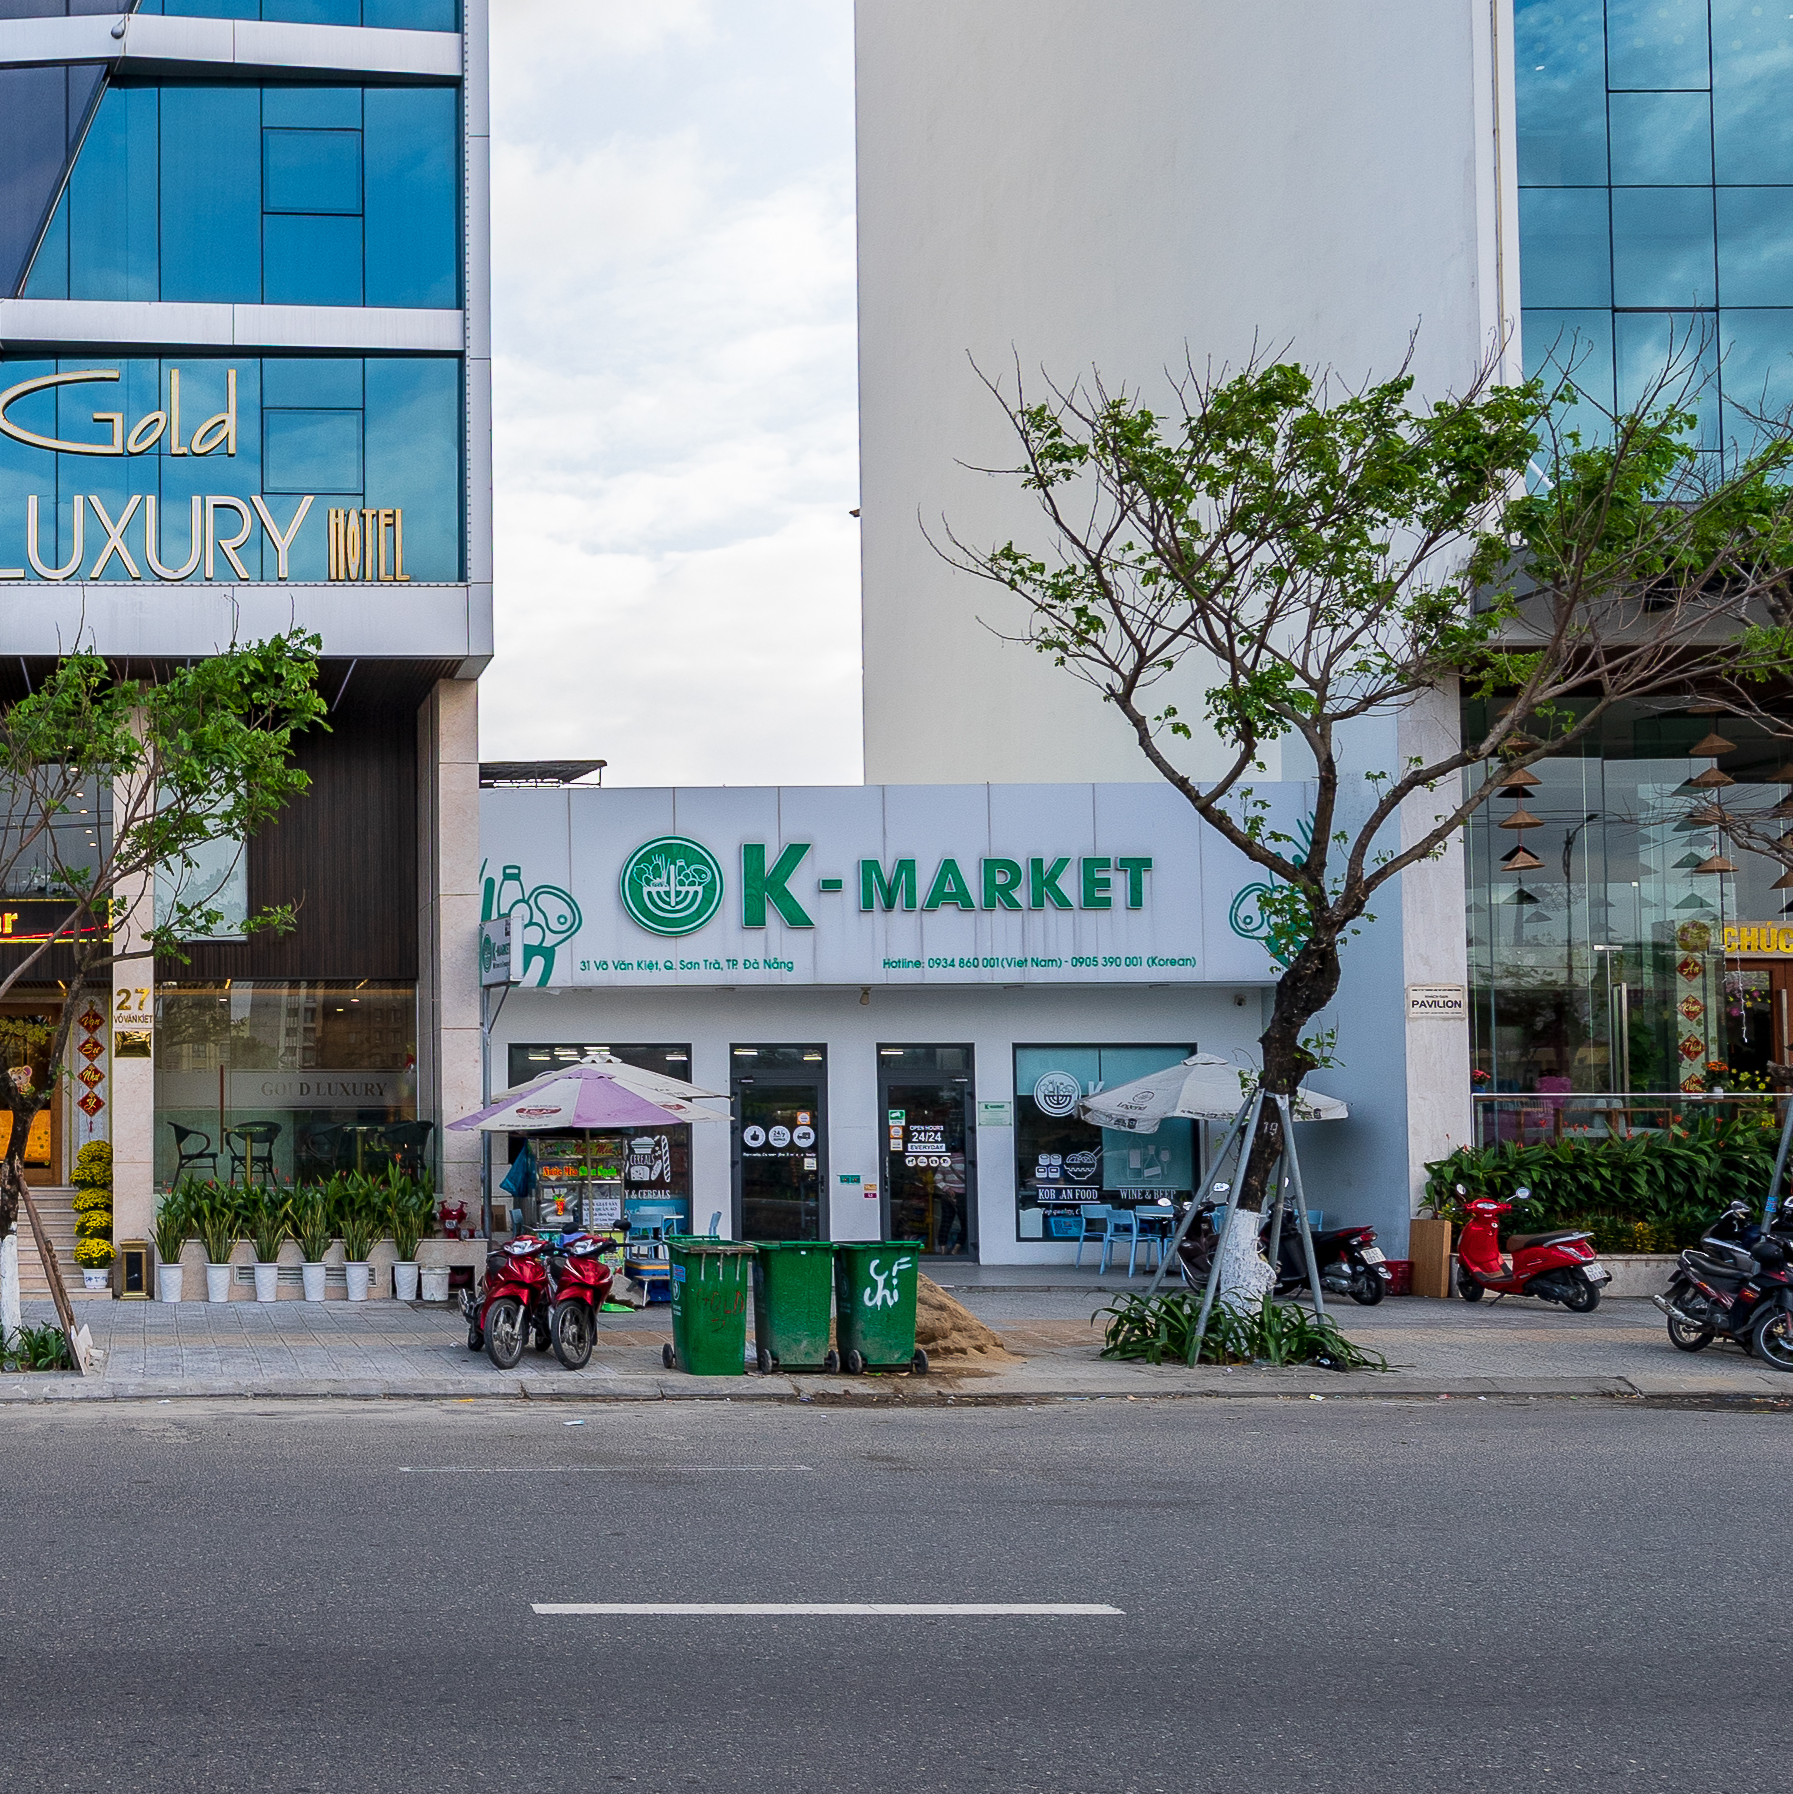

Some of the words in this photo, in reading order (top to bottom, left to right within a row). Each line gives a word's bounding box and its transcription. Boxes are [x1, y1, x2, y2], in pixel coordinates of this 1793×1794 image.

[328, 508, 410, 581] HOTEL
[1722, 921, 1793, 954] CHÚC
[579, 960, 591, 971] 31
[593, 959, 609, 971] Võ
[611, 959, 634, 971] Văn
[637, 959, 662, 973] Kiệt,
[663, 959, 677, 971] Q.
[679, 959, 700, 971] Sơn
[703, 959, 723, 972] Trà,
[726, 959, 738, 970] TP.
[743, 958, 760, 970] Đà
[763, 957, 795, 972] Nẵng
[883, 957, 925, 969] Hotline:
[928, 957, 955, 969] 0934
[958, 957, 979, 969] 860
[1030, 956, 1063, 970] Nam)
[1070, 956, 1099, 968] 0905
[1101, 956, 1122, 968] 390
[1124, 956, 1144, 968] 001
[1146, 955, 1197, 969] (Korean)
[116, 988, 151, 1010] 27
[1411, 1000, 1462, 1009] PAVILION
[316, 1081, 387, 1097] LUXURY
[912, 1131, 941, 1142] 24/24
[629, 1154, 655, 1165] CEREALS
[638, 1190, 671, 1199] CEREALS
[1075, 1189, 1098, 1200] FOOD
[1120, 1189, 1144, 1200] WINE
